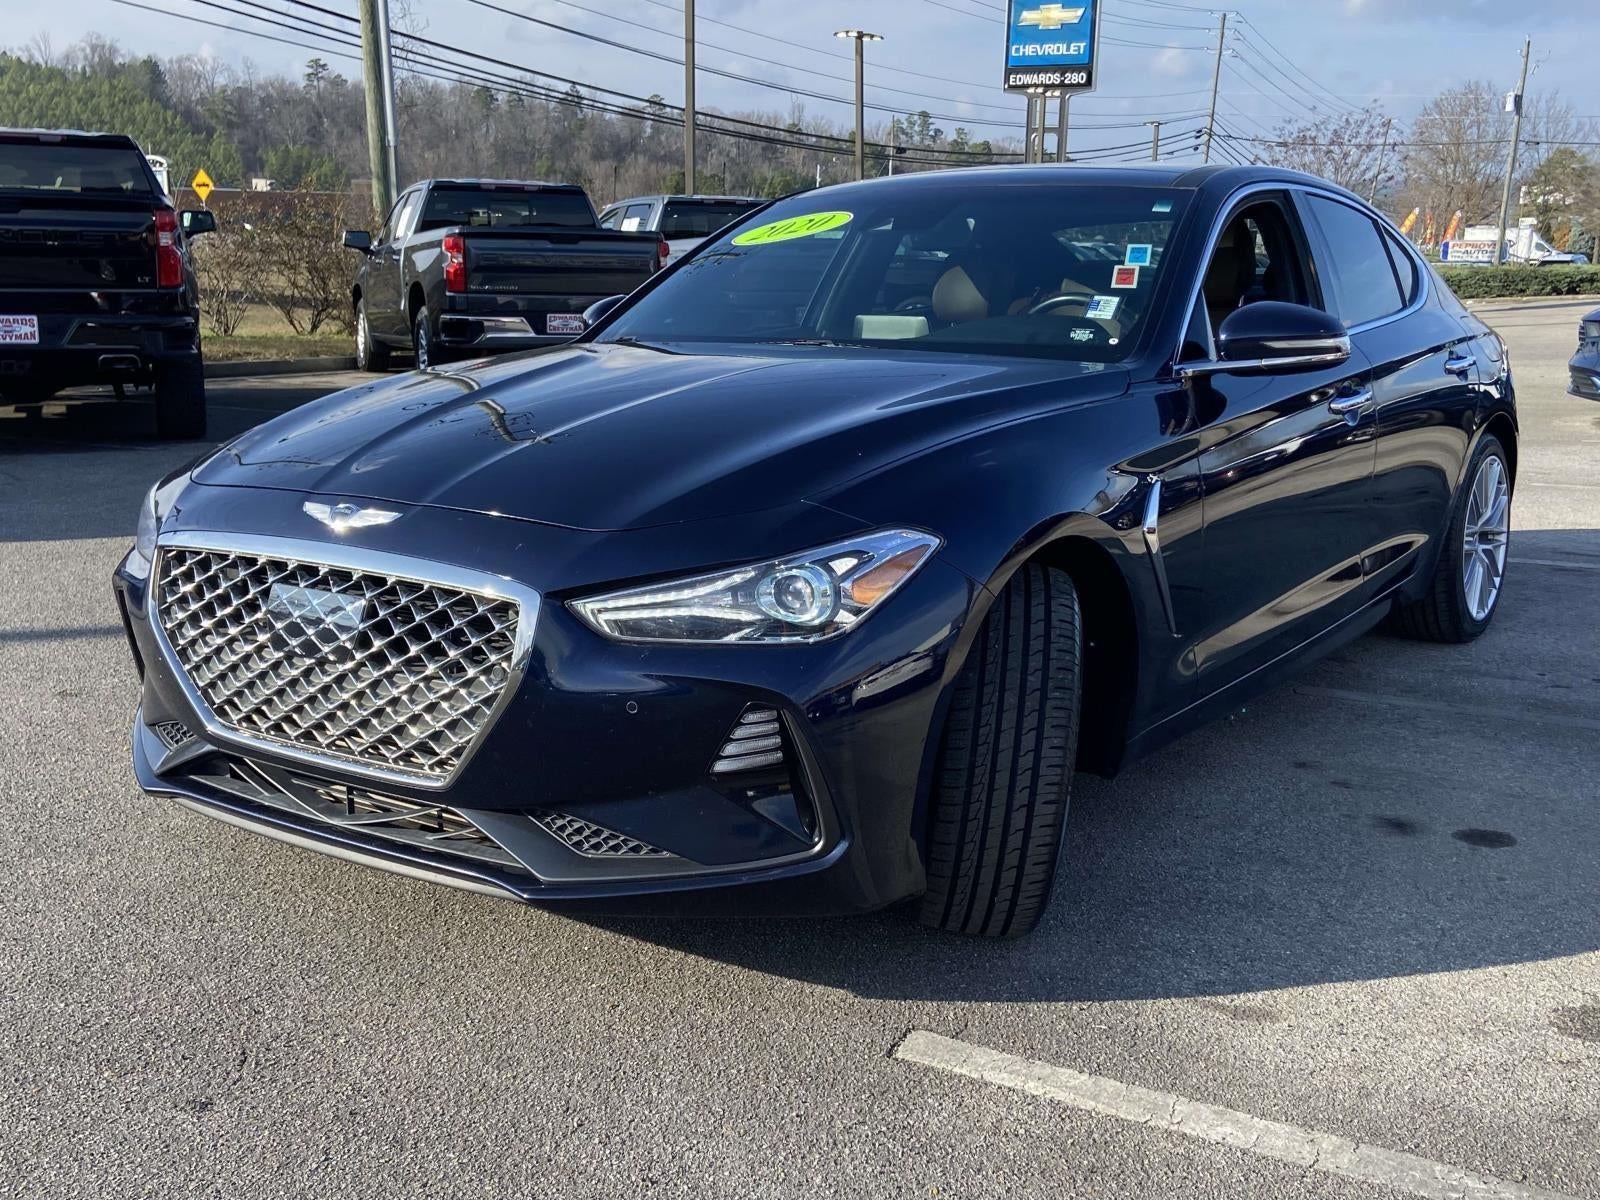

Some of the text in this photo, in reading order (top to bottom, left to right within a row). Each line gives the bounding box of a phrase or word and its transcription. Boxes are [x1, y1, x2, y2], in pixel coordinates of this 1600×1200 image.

[1011, 42, 1087, 56] CHEVROLET
[1009, 72, 1087, 85] EDWARDS-280
[744, 214, 837, 242] 2020
